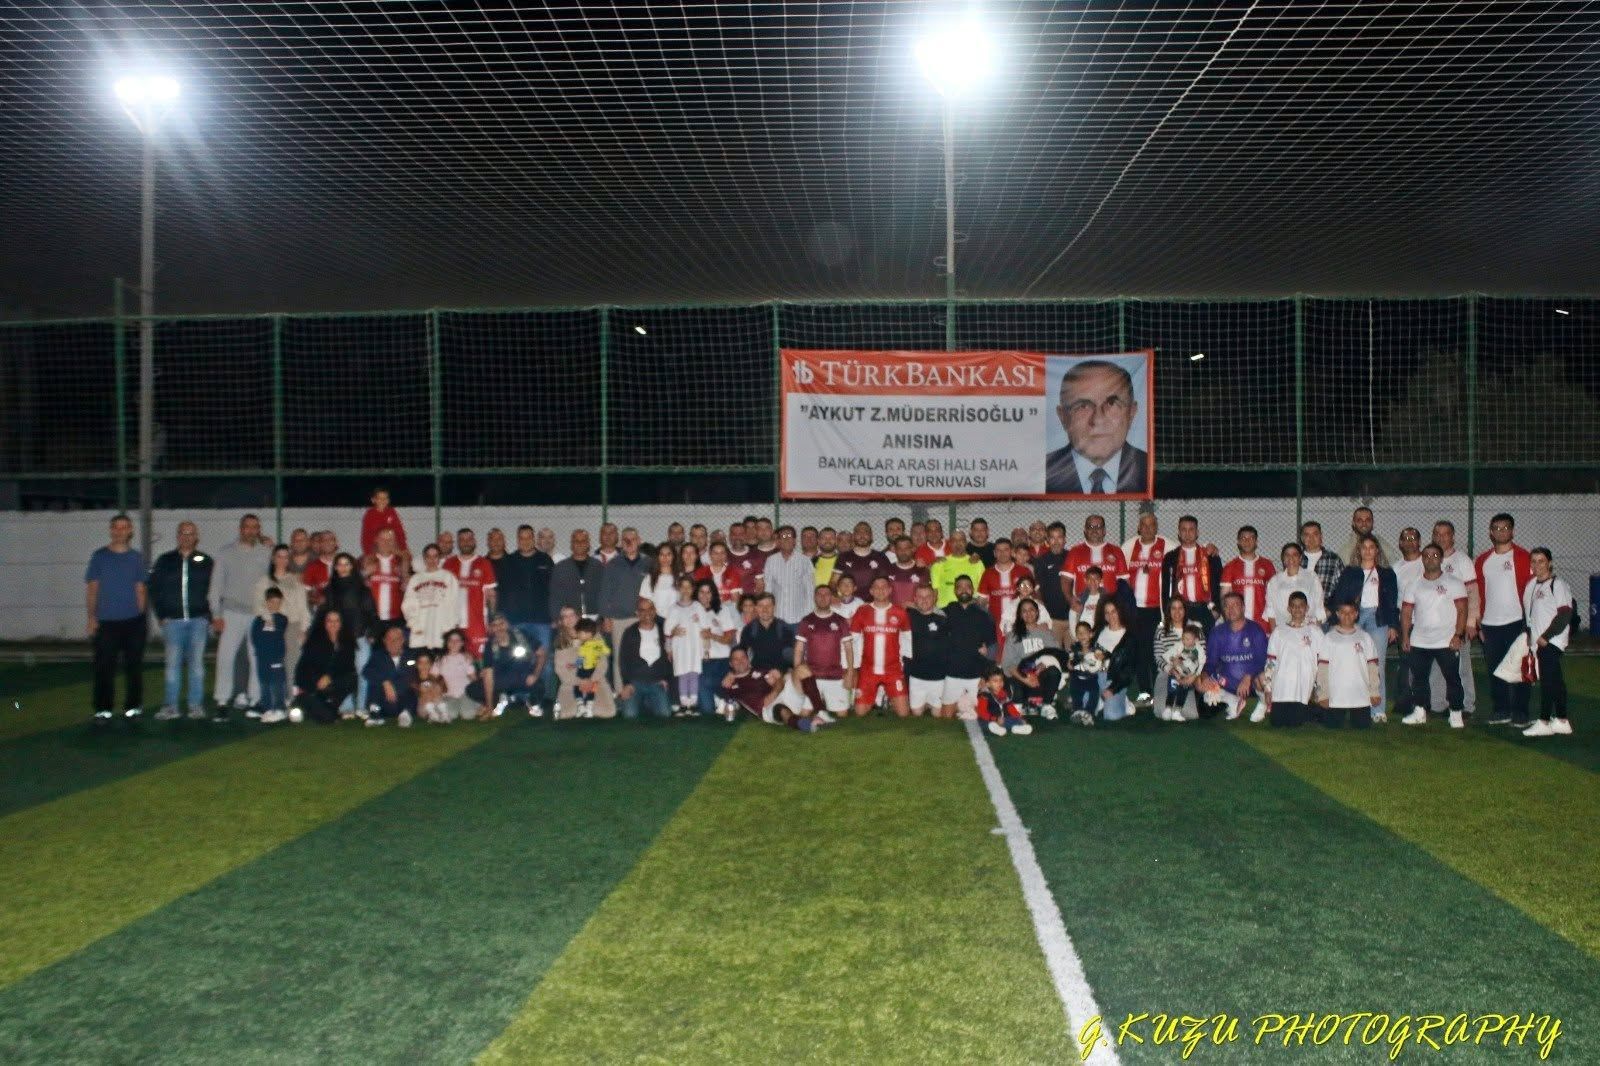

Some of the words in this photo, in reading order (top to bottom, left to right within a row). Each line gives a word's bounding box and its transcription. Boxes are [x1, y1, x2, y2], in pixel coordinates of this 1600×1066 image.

[882, 433, 954, 449] ANISINA
[818, 456, 894, 471] BANKALAR
[899, 458, 940, 471] ARASI
[944, 459, 975, 471] HALI
[979, 459, 1018, 471] SAHA
[849, 474, 902, 487] FUTBOL
[908, 475, 986, 488] TURNUVASI
